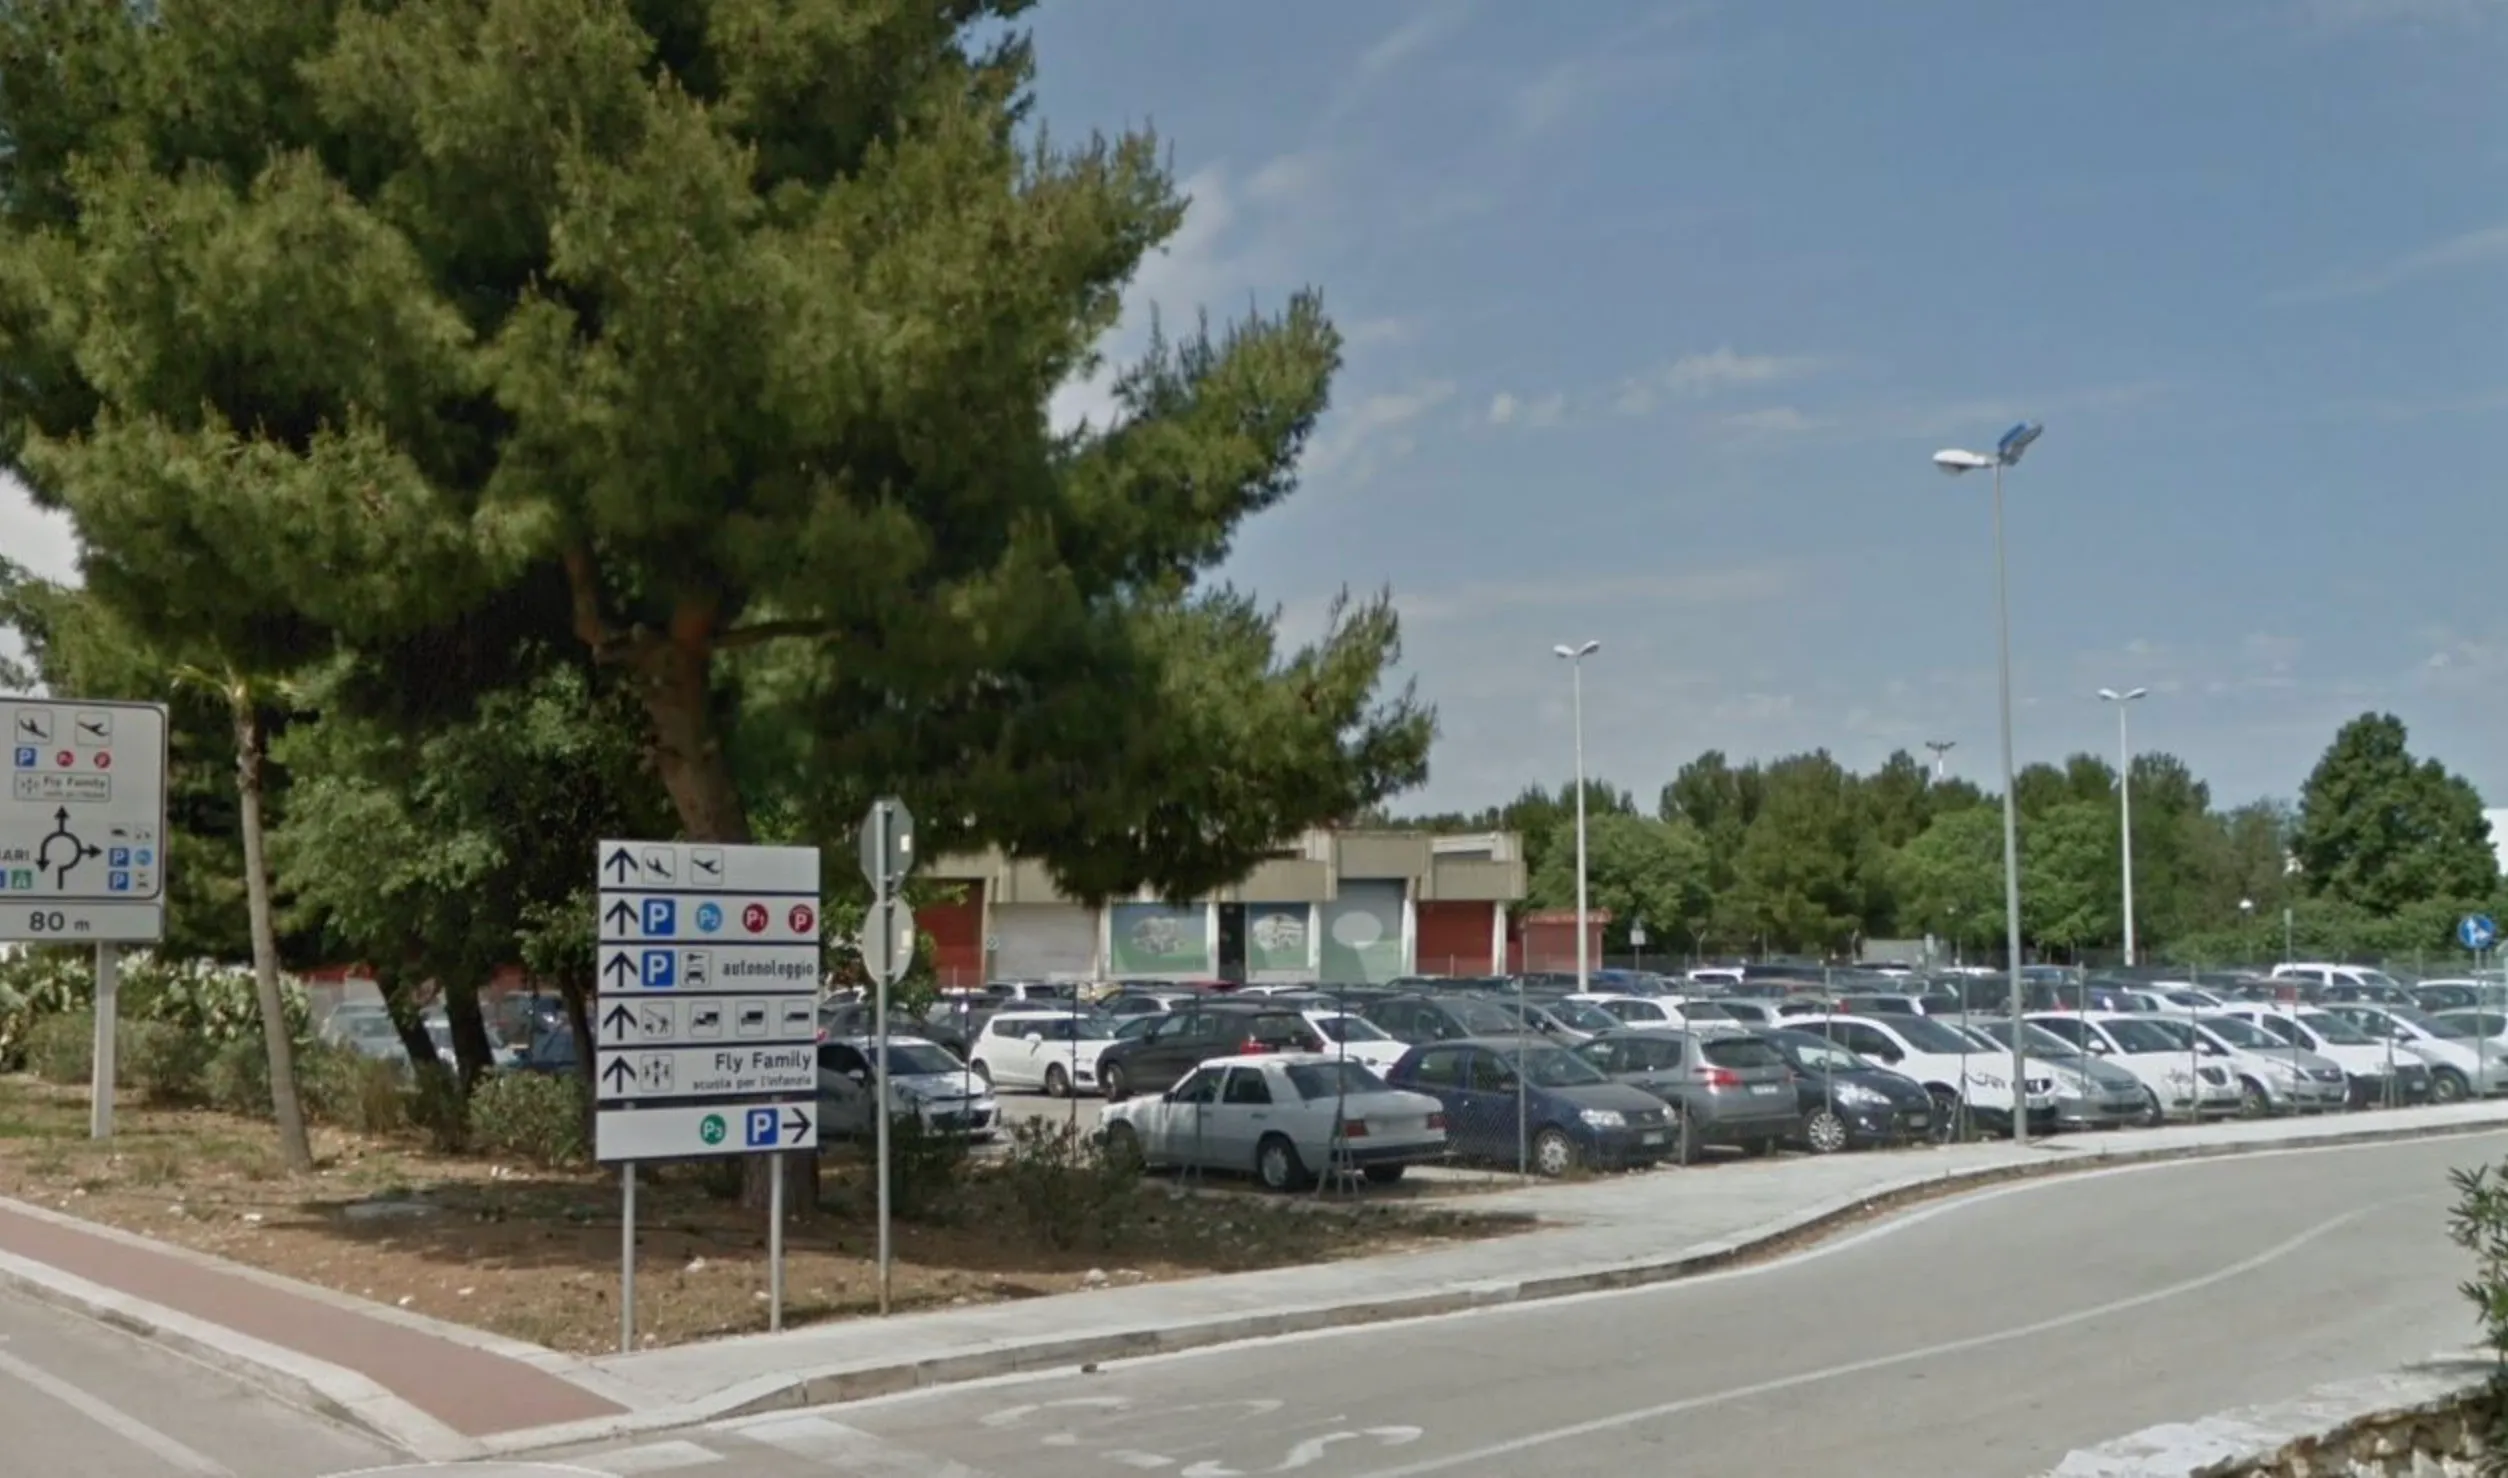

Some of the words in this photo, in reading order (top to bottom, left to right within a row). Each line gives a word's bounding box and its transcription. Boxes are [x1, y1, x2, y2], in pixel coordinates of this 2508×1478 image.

[0, 849, 30, 861] ARI
[29, 911, 65, 932] 80
[74, 918, 90, 932] m
[649, 903, 668, 932] P
[649, 956, 668, 984] P
[722, 960, 814, 981] autonoleggio
[715, 1053, 743, 1074] Fly
[752, 1050, 812, 1071] Family
[692, 1079, 732, 1090] scuola
[736, 1079, 756, 1090] per
[752, 1113, 772, 1143] P
